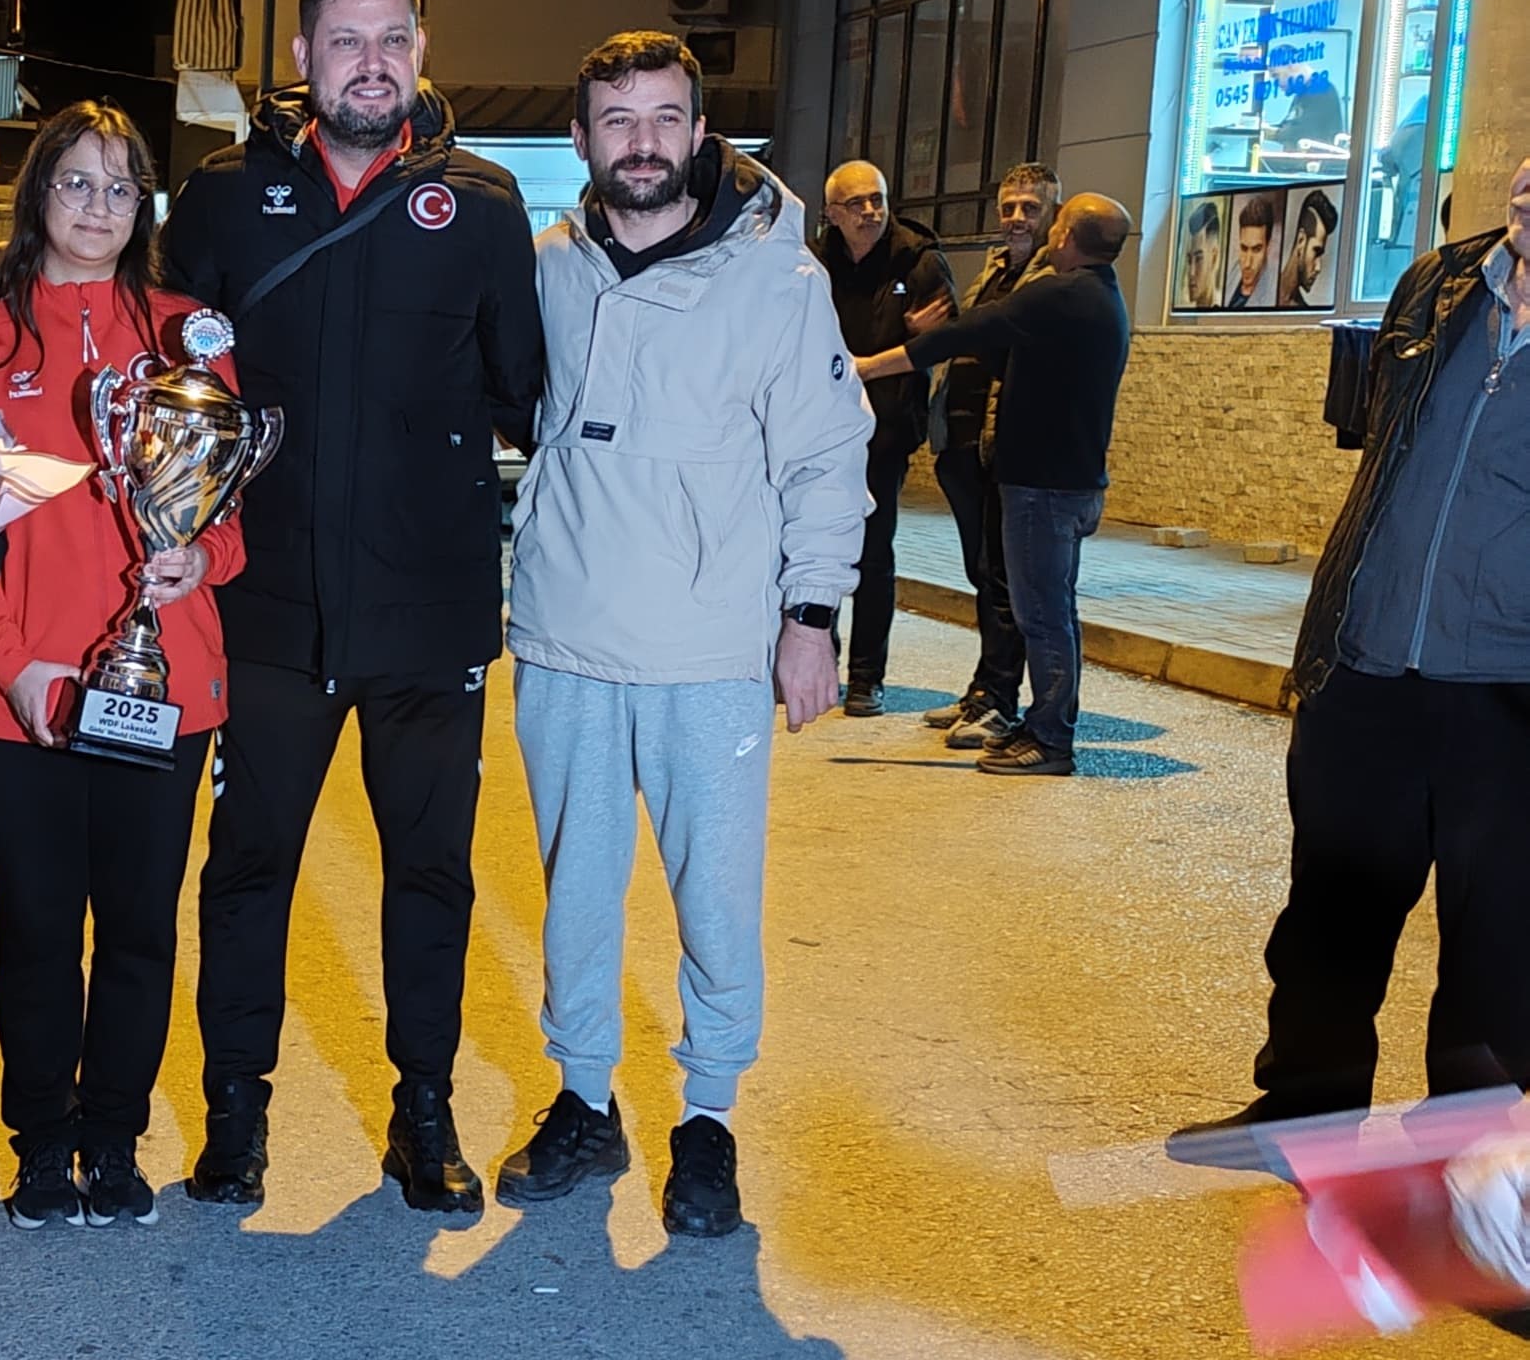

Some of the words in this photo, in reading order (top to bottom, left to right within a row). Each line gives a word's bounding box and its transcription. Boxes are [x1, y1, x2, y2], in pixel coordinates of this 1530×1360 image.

[1216, 84, 1249, 107] 0545
[103, 698, 160, 724] 2025
[99, 717, 119, 728] WDF
[121, 722, 158, 736] Lakeside
